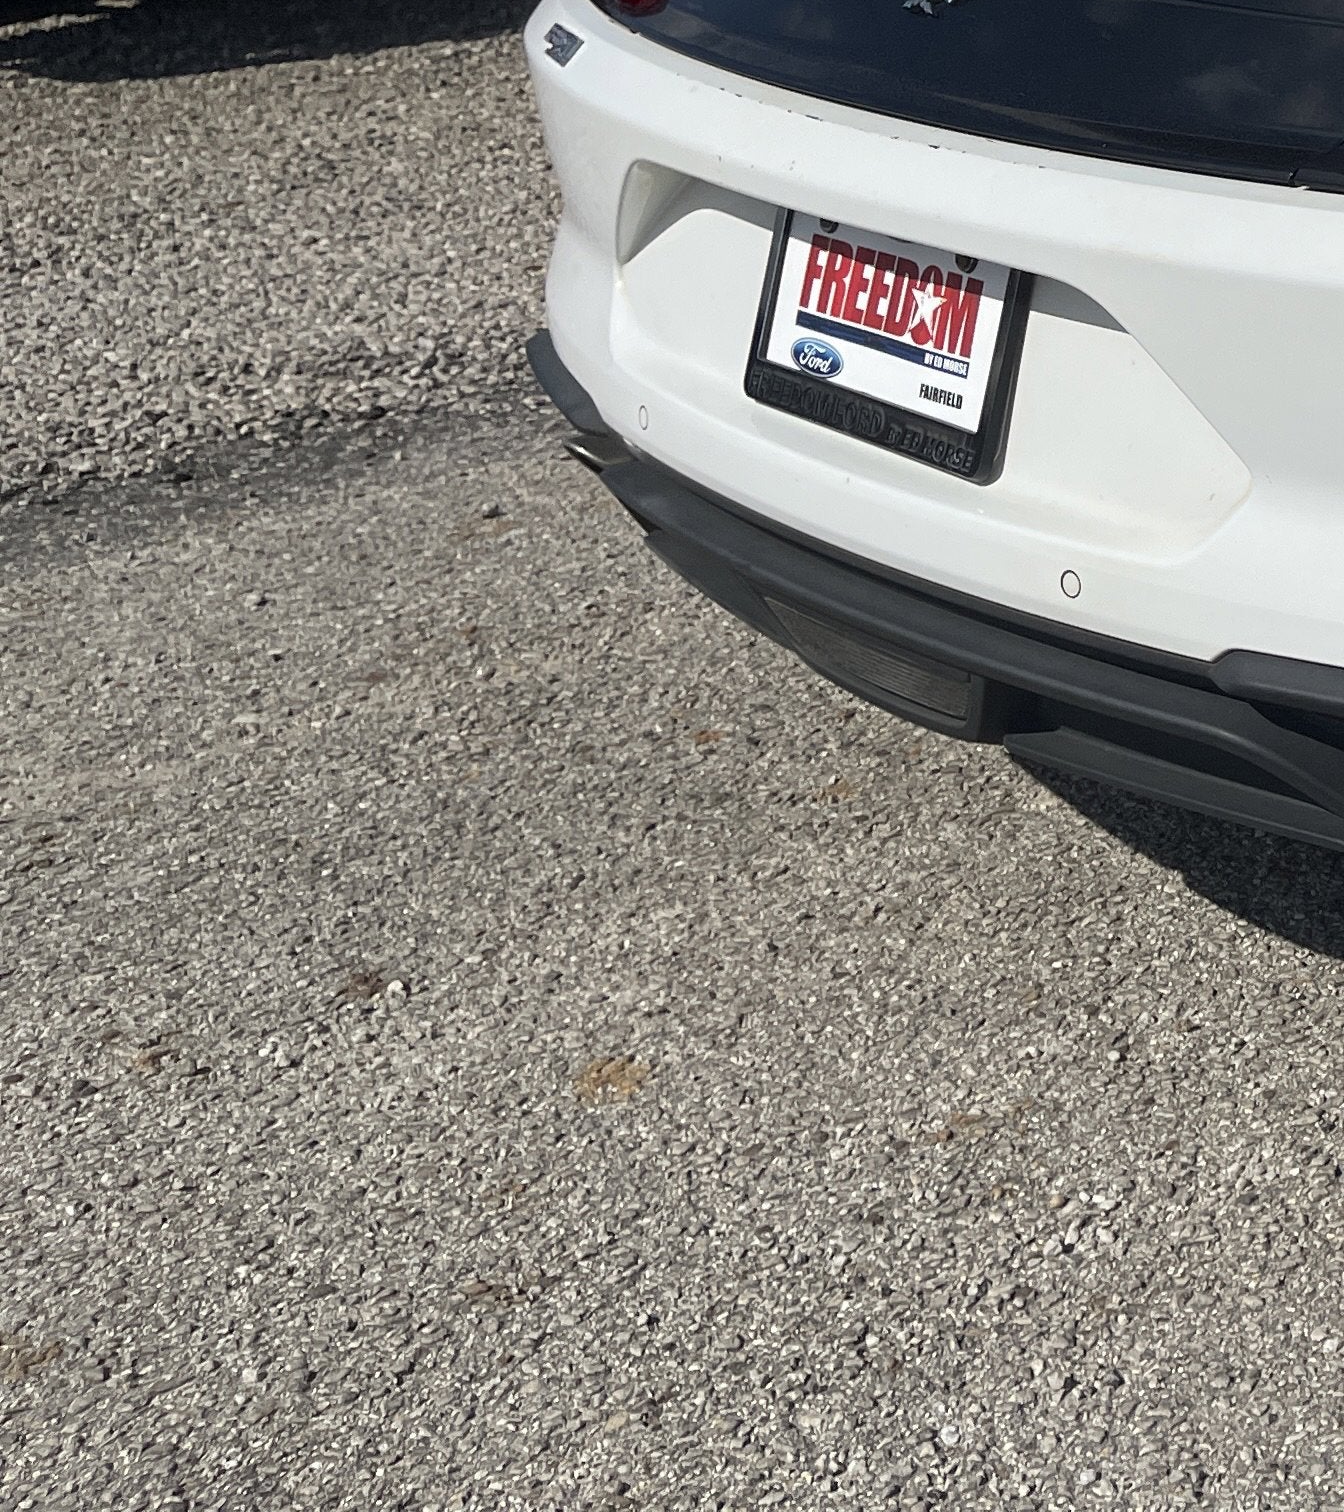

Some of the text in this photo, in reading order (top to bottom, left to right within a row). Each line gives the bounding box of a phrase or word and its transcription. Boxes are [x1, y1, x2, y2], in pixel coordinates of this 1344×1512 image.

[799, 234, 985, 359] FREEDOM
[799, 344, 832, 373] Ford
[942, 357, 968, 376] MORSE
[918, 383, 963, 410] FAIRFIELD
